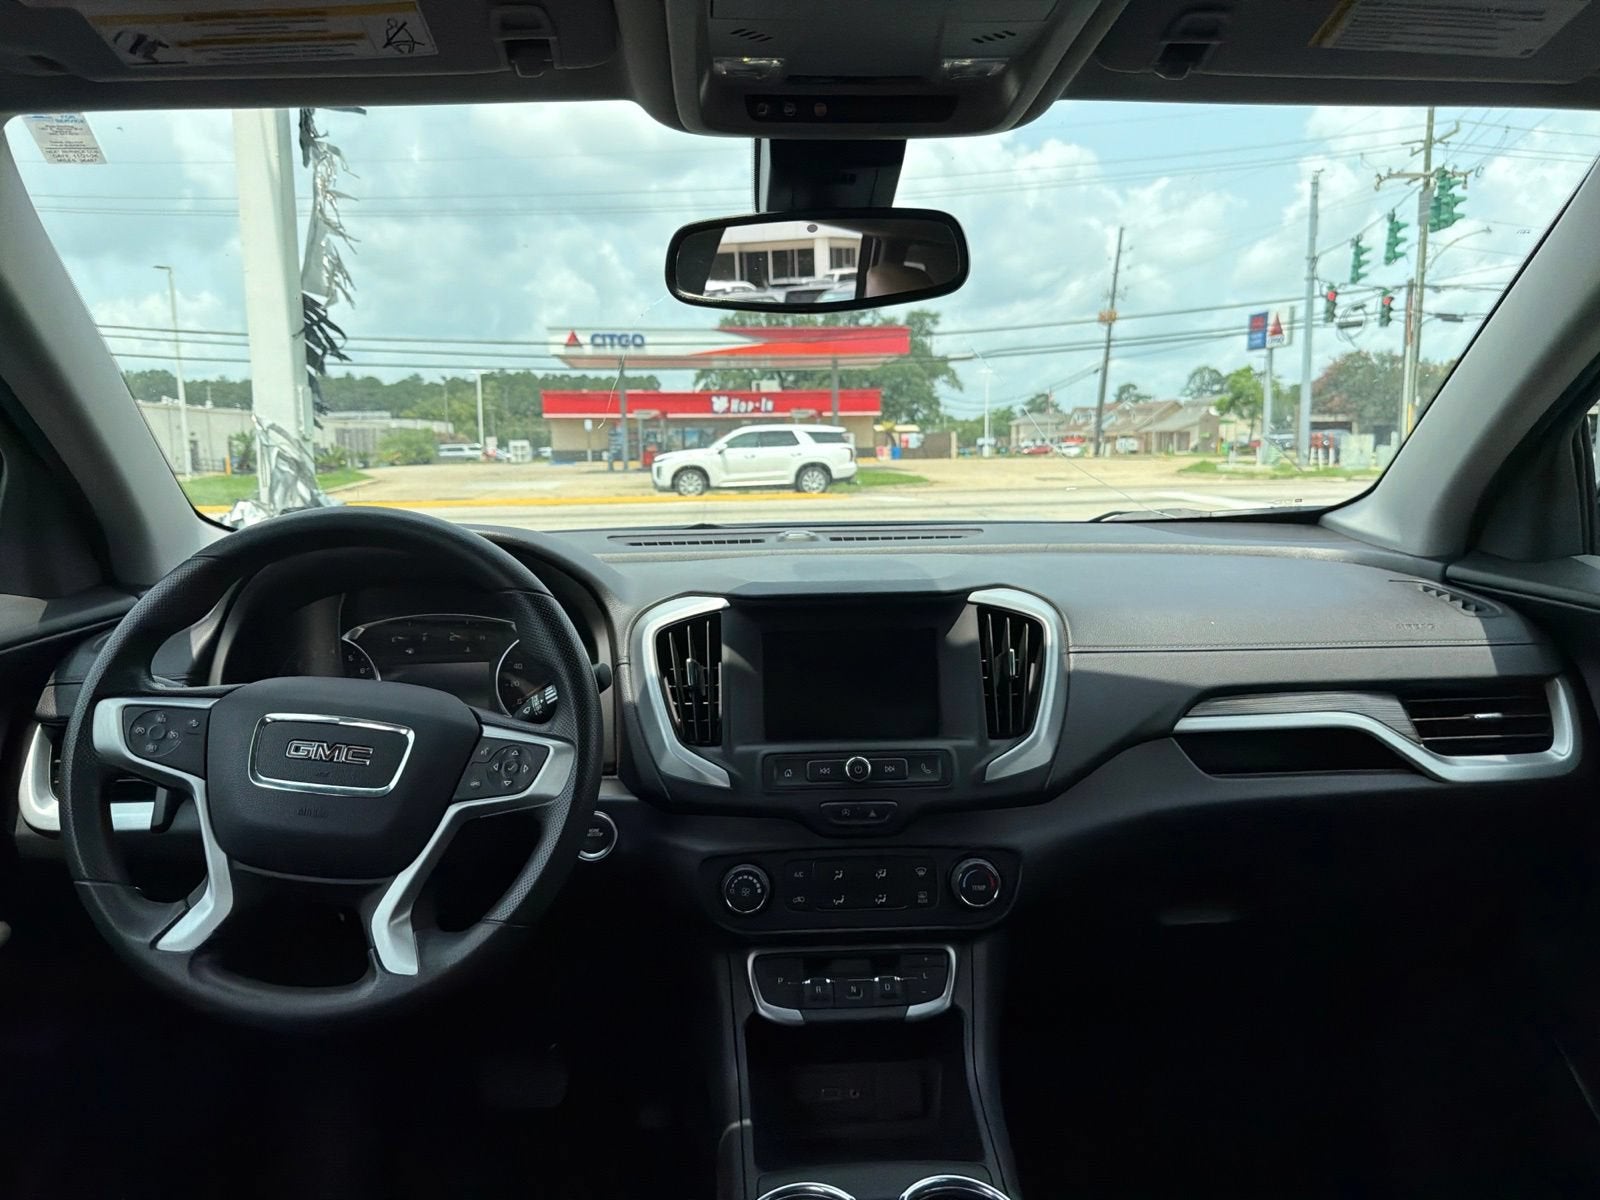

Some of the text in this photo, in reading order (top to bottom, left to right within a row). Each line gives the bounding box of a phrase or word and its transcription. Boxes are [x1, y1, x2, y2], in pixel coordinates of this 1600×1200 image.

[590, 333, 645, 348] CITGO
[284, 739, 374, 767] GMC
[922, 971, 929, 980] L
[815, 985, 822, 993] R
[850, 985, 857, 993] N
[884, 983, 892, 991] D
